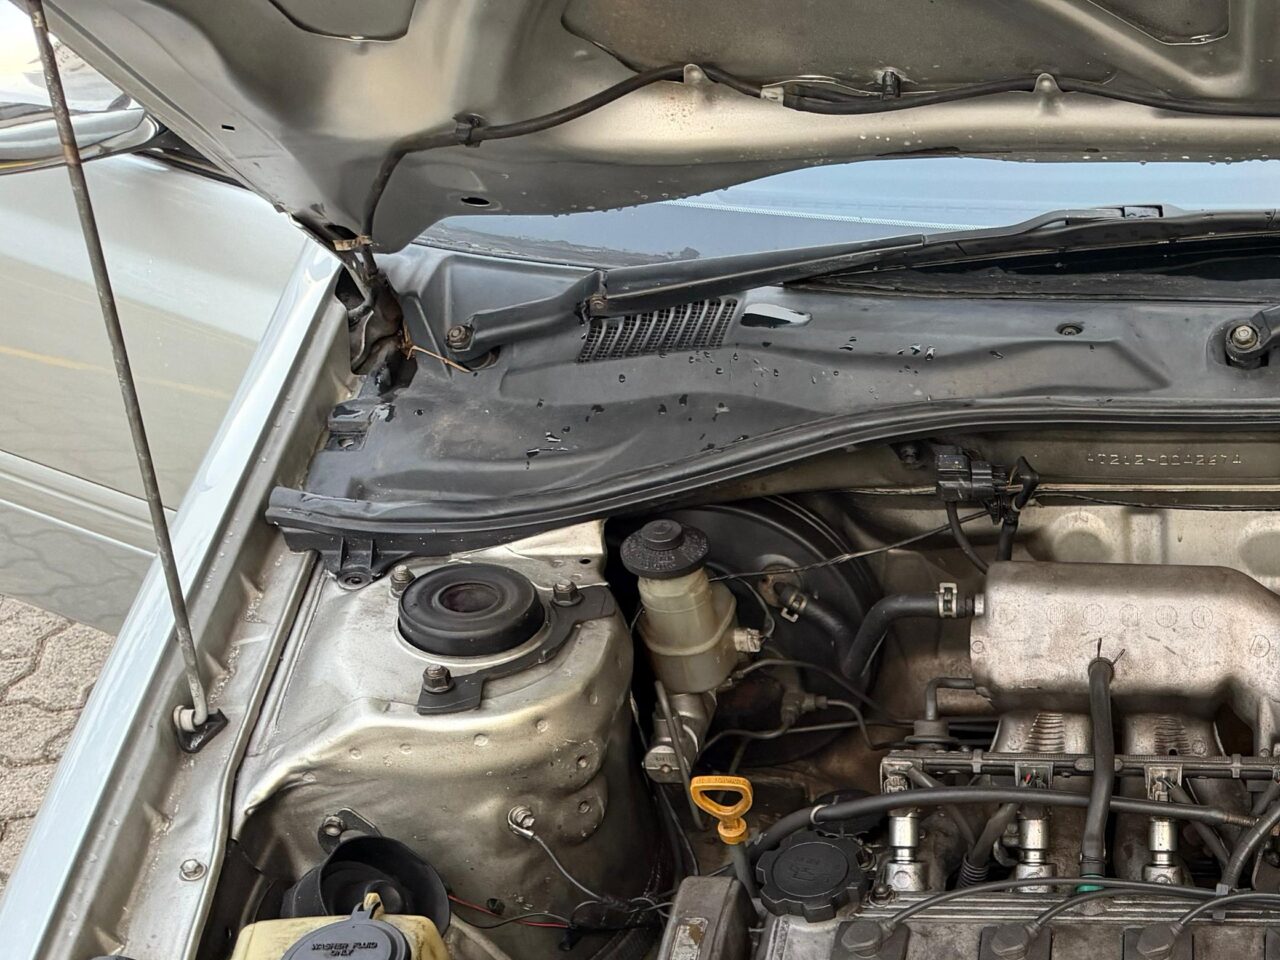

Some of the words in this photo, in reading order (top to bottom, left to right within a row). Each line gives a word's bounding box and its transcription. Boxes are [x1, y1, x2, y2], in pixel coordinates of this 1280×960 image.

[312, 943, 349, 951] WASHER
[352, 941, 378, 949] FLUID
[329, 949, 354, 957] ONLY
